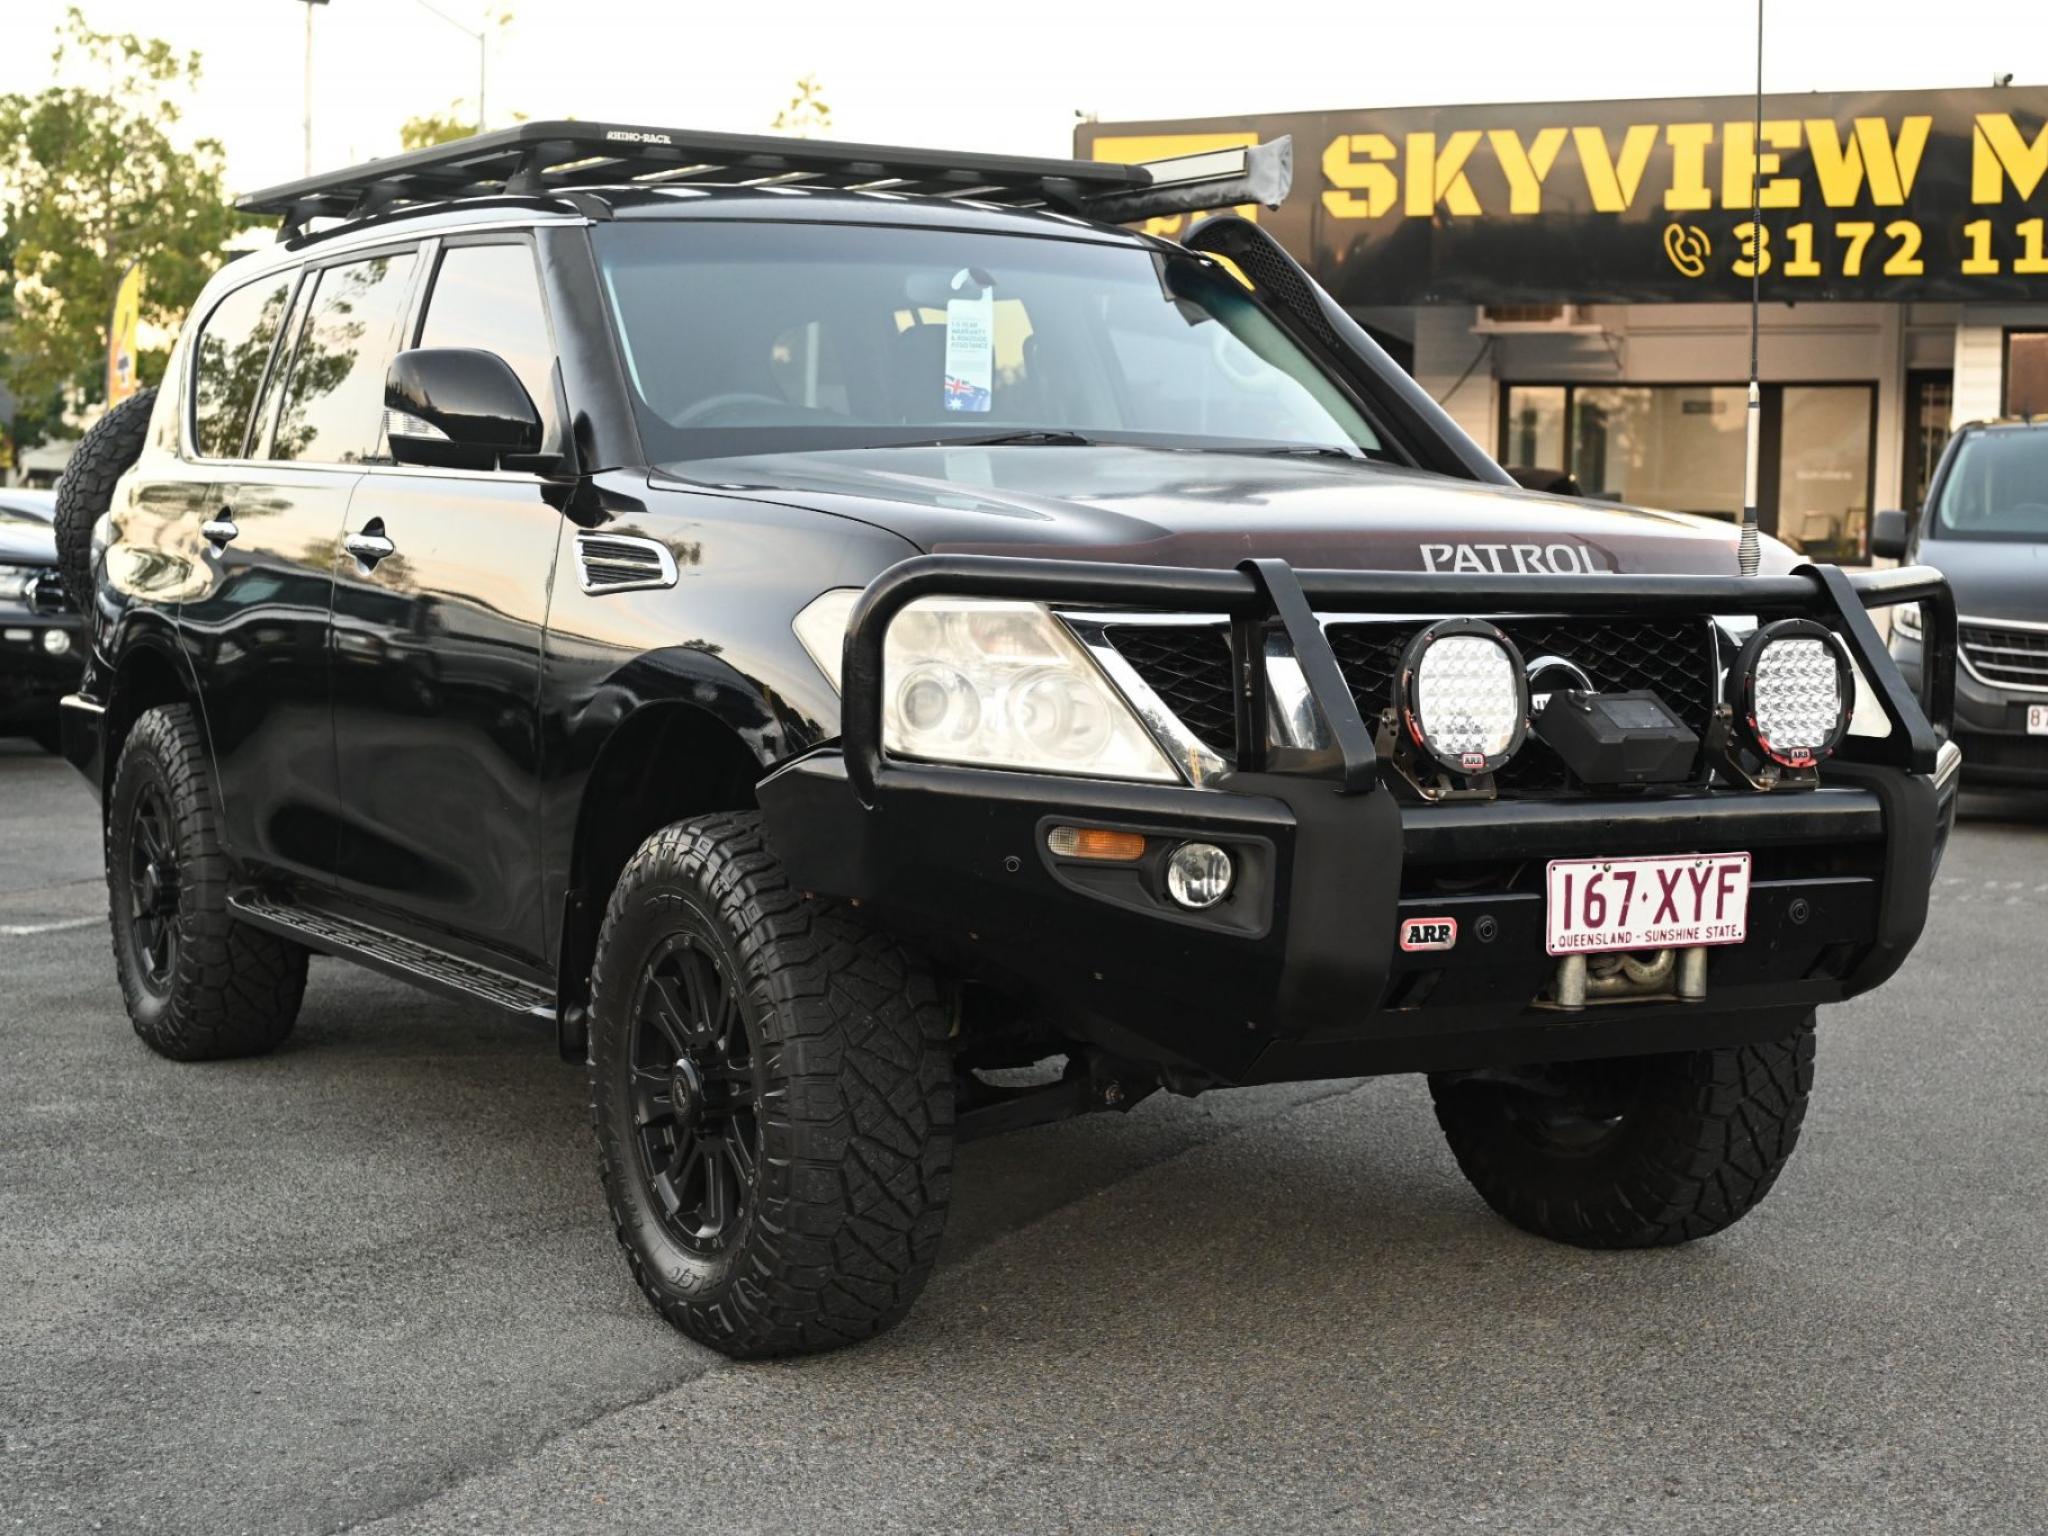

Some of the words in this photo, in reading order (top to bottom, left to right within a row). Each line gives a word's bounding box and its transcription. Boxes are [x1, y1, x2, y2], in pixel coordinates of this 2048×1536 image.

[1321, 115, 1933, 219] SKYVIEW
[1731, 220, 1924, 278] 3172
[1420, 543, 1614, 574] PATROL
[1558, 931, 1633, 948] QUEENSLAND
[1644, 926, 1701, 941] SUNSHINE
[1705, 924, 1737, 939] STATE
